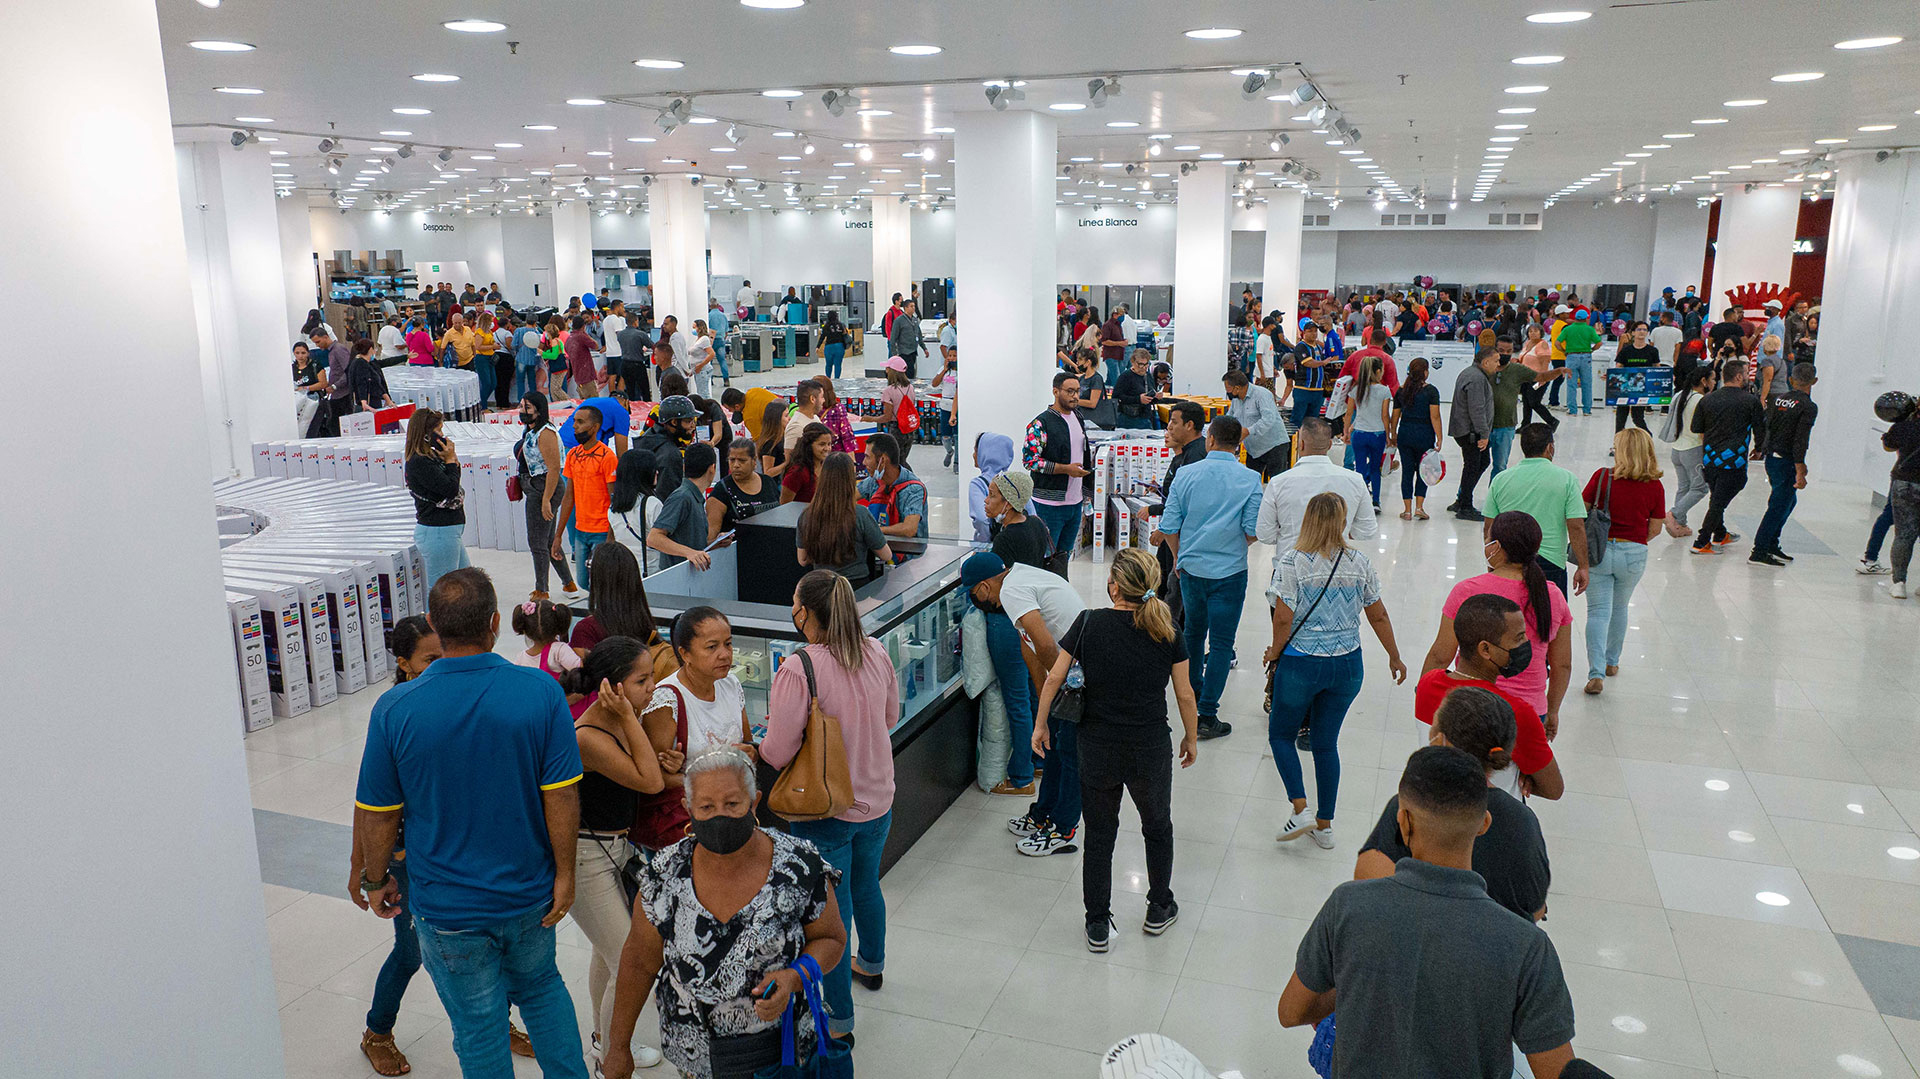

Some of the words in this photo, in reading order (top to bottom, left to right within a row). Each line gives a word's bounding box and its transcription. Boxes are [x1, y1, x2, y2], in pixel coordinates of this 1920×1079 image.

[423, 223, 455, 233] Despacho
[1078, 217, 1104, 228] Línea
[1105, 218, 1138, 227] Blanca
[399, 600, 406, 612] 50
[370, 612, 380, 625] 50
[347, 621, 358, 634] 50
[314, 631, 328, 645] 50
[287, 641, 300, 655] 50
[247, 653, 262, 667] 50
